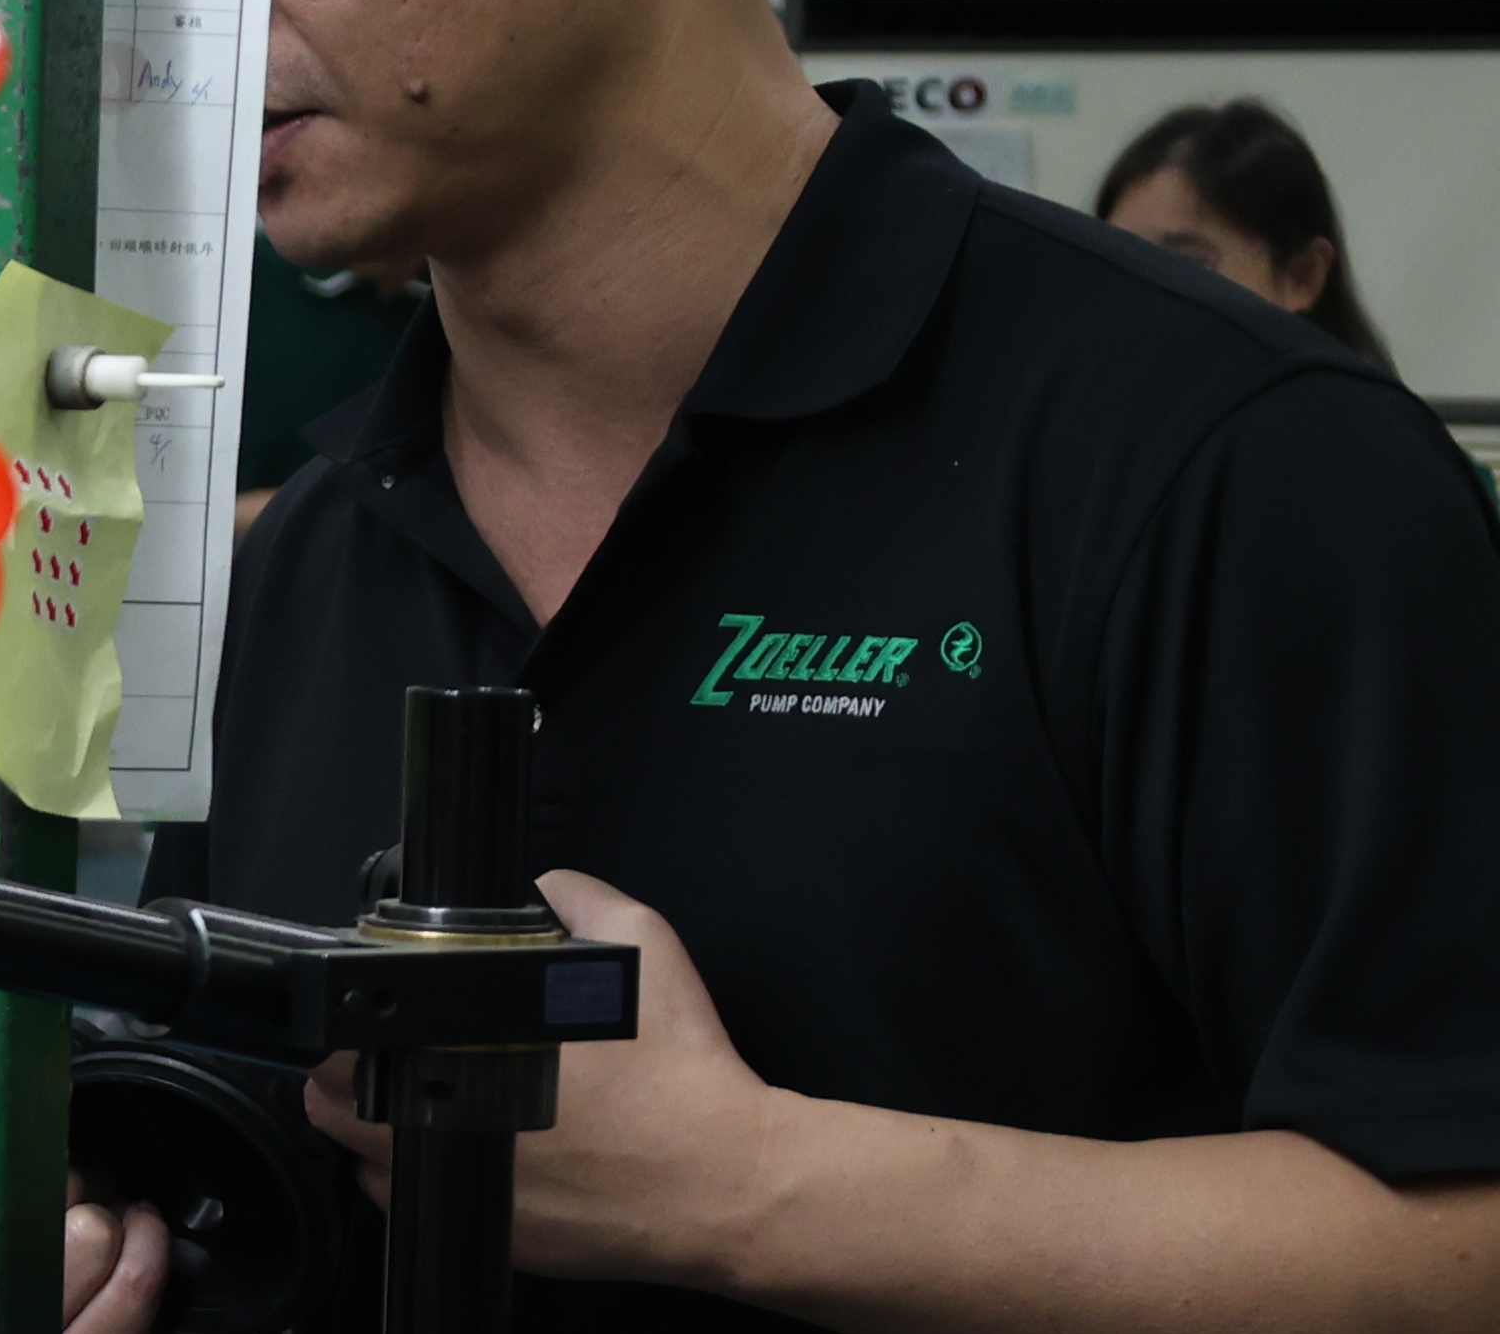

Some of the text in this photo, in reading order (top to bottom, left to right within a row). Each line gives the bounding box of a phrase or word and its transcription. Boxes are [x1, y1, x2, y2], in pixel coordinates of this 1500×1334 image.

[689, 613, 919, 707] ZOELLER
[748, 693, 886, 718] PUMP COMPANY
